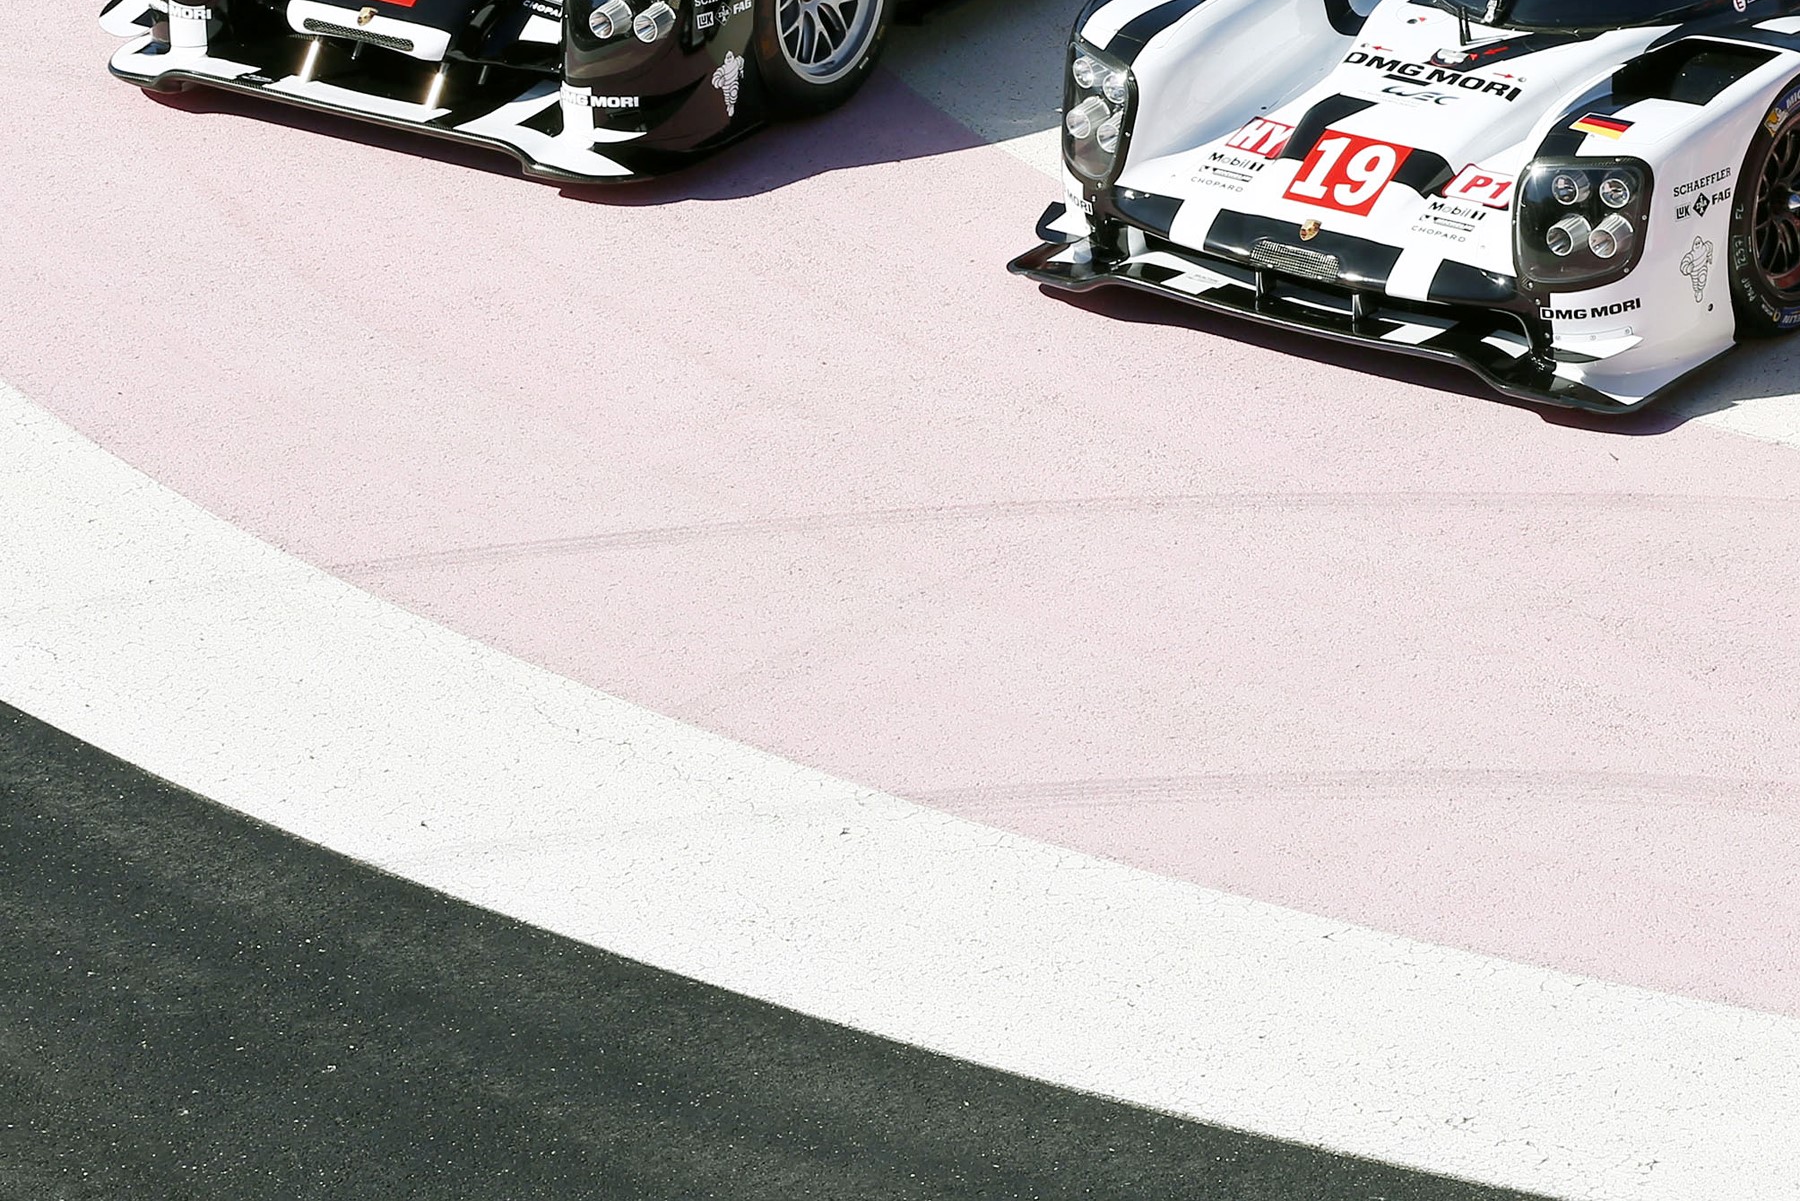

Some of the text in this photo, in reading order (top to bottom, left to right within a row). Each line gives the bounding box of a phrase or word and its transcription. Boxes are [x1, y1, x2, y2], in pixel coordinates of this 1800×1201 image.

[1343, 51, 1425, 77] DMG
[1425, 69, 1523, 103] MORI
[590, 95, 639, 108] MORI
[1226, 117, 1296, 155] HY
[1208, 152, 1252, 168] Mobil
[1289, 136, 1398, 206] 19
[1191, 176, 1244, 192] CHOPARD
[1459, 175, 1513, 200] P1
[1673, 167, 1731, 197] SCHAEFFLER
[1711, 187, 1731, 205] FAG
[1428, 201, 1472, 218] Mobil
[1411, 225, 1466, 242] CHOPARD
[1541, 298, 1641, 320] DMG MORI
